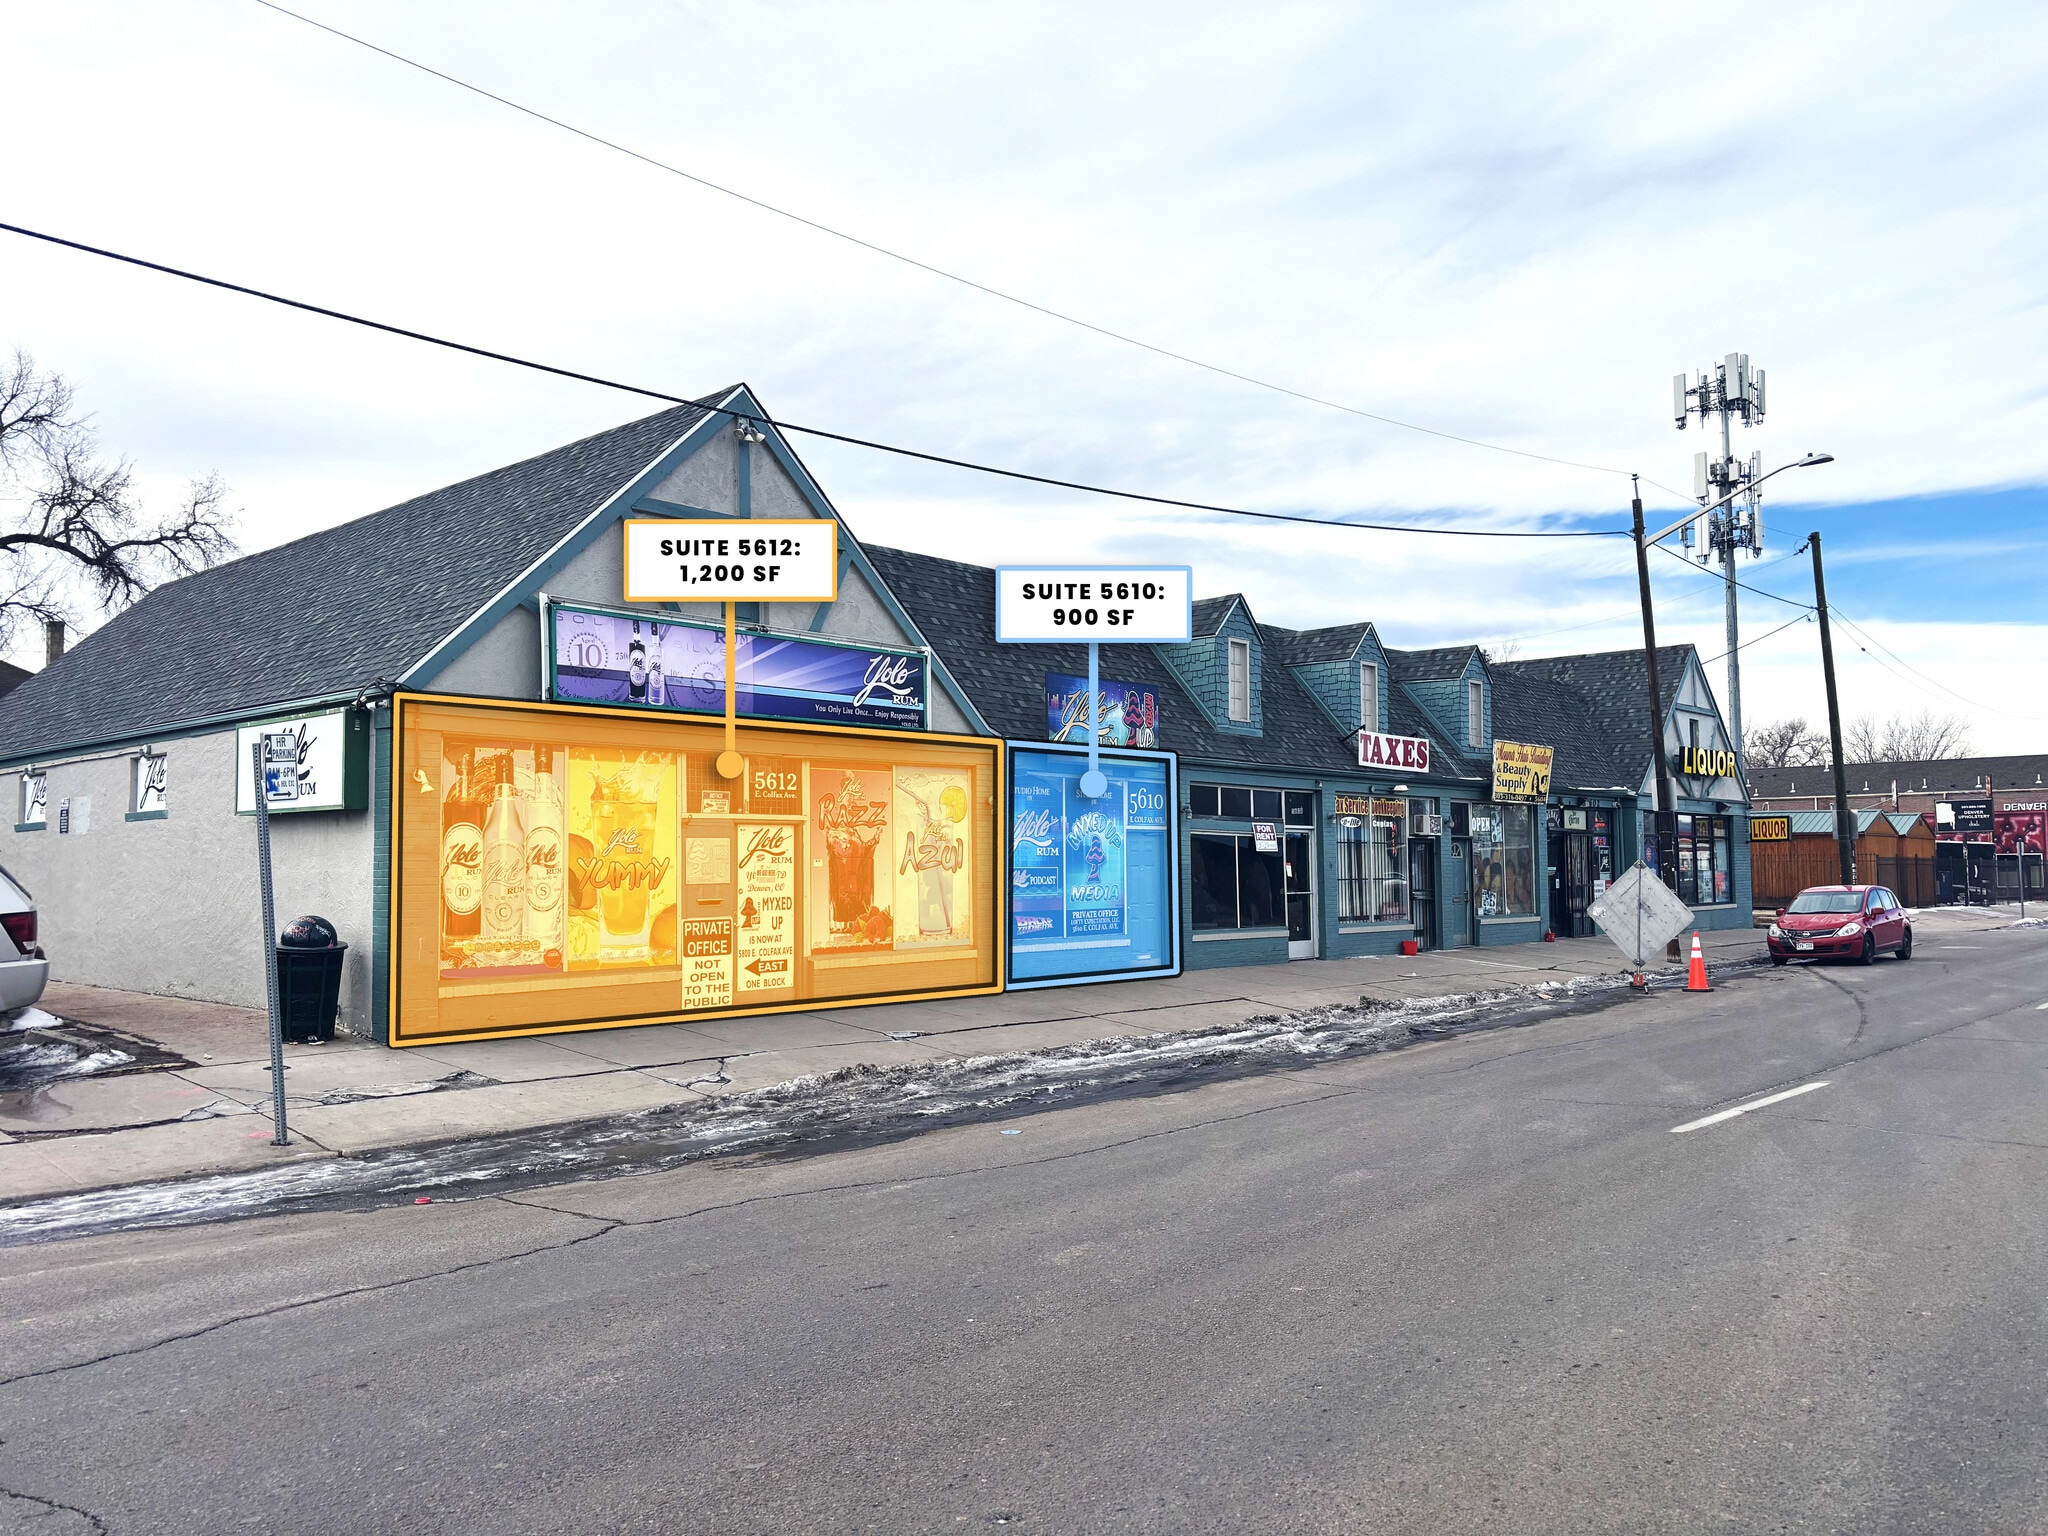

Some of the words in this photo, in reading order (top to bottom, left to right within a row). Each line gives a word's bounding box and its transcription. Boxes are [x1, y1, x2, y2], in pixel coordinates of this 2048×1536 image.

[573, 643, 602, 668] 10
[853, 654, 919, 707] Yolo
[891, 694, 919, 706] RUM
[815, 703, 827, 712] You
[827, 705, 842, 716] Only
[842, 706, 854, 715] Live
[875, 709, 890, 720] Enjoy
[890, 711, 920, 722] Responsibly
[265, 739, 272, 758] 2
[276, 736, 286, 748] HR
[272, 748, 295, 760] PARKING
[1360, 733, 1428, 770] TAXES
[1684, 746, 1736, 778] LIQUOR
[1496, 763, 1502, 773] &
[1503, 762, 1531, 779] Beauty
[754, 771, 797, 791] 5612
[1496, 775, 1528, 792] Supply
[298, 781, 317, 797] UM
[755, 790, 762, 798] E.
[762, 790, 783, 798] Colfax
[1014, 786, 1033, 796] TUDIO
[1129, 787, 1164, 814] 5610
[1344, 796, 1369, 814] Service
[2003, 802, 2047, 811] DENVER
[818, 792, 888, 830] RAZZ
[1256, 825, 1272, 833] FOR
[1471, 817, 1491, 832] OPEN
[1753, 820, 1787, 838] LIQUOR
[602, 826, 644, 857] Yolo
[739, 827, 793, 869] Yolo
[1036, 847, 1059, 856] RUM
[442, 842, 482, 877] Yolo
[770, 856, 793, 864] RUM
[577, 856, 671, 892] YUMMY
[1030, 875, 1057, 886] PODCAST
[1070, 884, 1120, 903] MEDIA
[762, 897, 793, 911] MYXED
[1072, 910, 1098, 919] PRIVATE
[1097, 909, 1119, 918] OFFICE
[684, 920, 731, 937] PRIVATE
[771, 916, 784, 931] UP
[1088, 923, 1108, 931] COLFAX
[749, 936, 755, 945] IS
[756, 935, 774, 944] NOW
[774, 934, 783, 943] AT
[687, 940, 728, 956] OFFICE
[738, 949, 751, 958] 5800
[758, 946, 782, 957] COLFAX
[782, 946, 793, 955] AVE
[694, 959, 721, 970] NOT
[758, 961, 785, 972] EAST
[689, 971, 725, 983] OPEN
[746, 979, 761, 989] ONE
[763, 977, 786, 987] BLOCK
[684, 985, 702, 996] TO
[705, 983, 730, 993] THE
[683, 995, 730, 1009] PUBLIC
